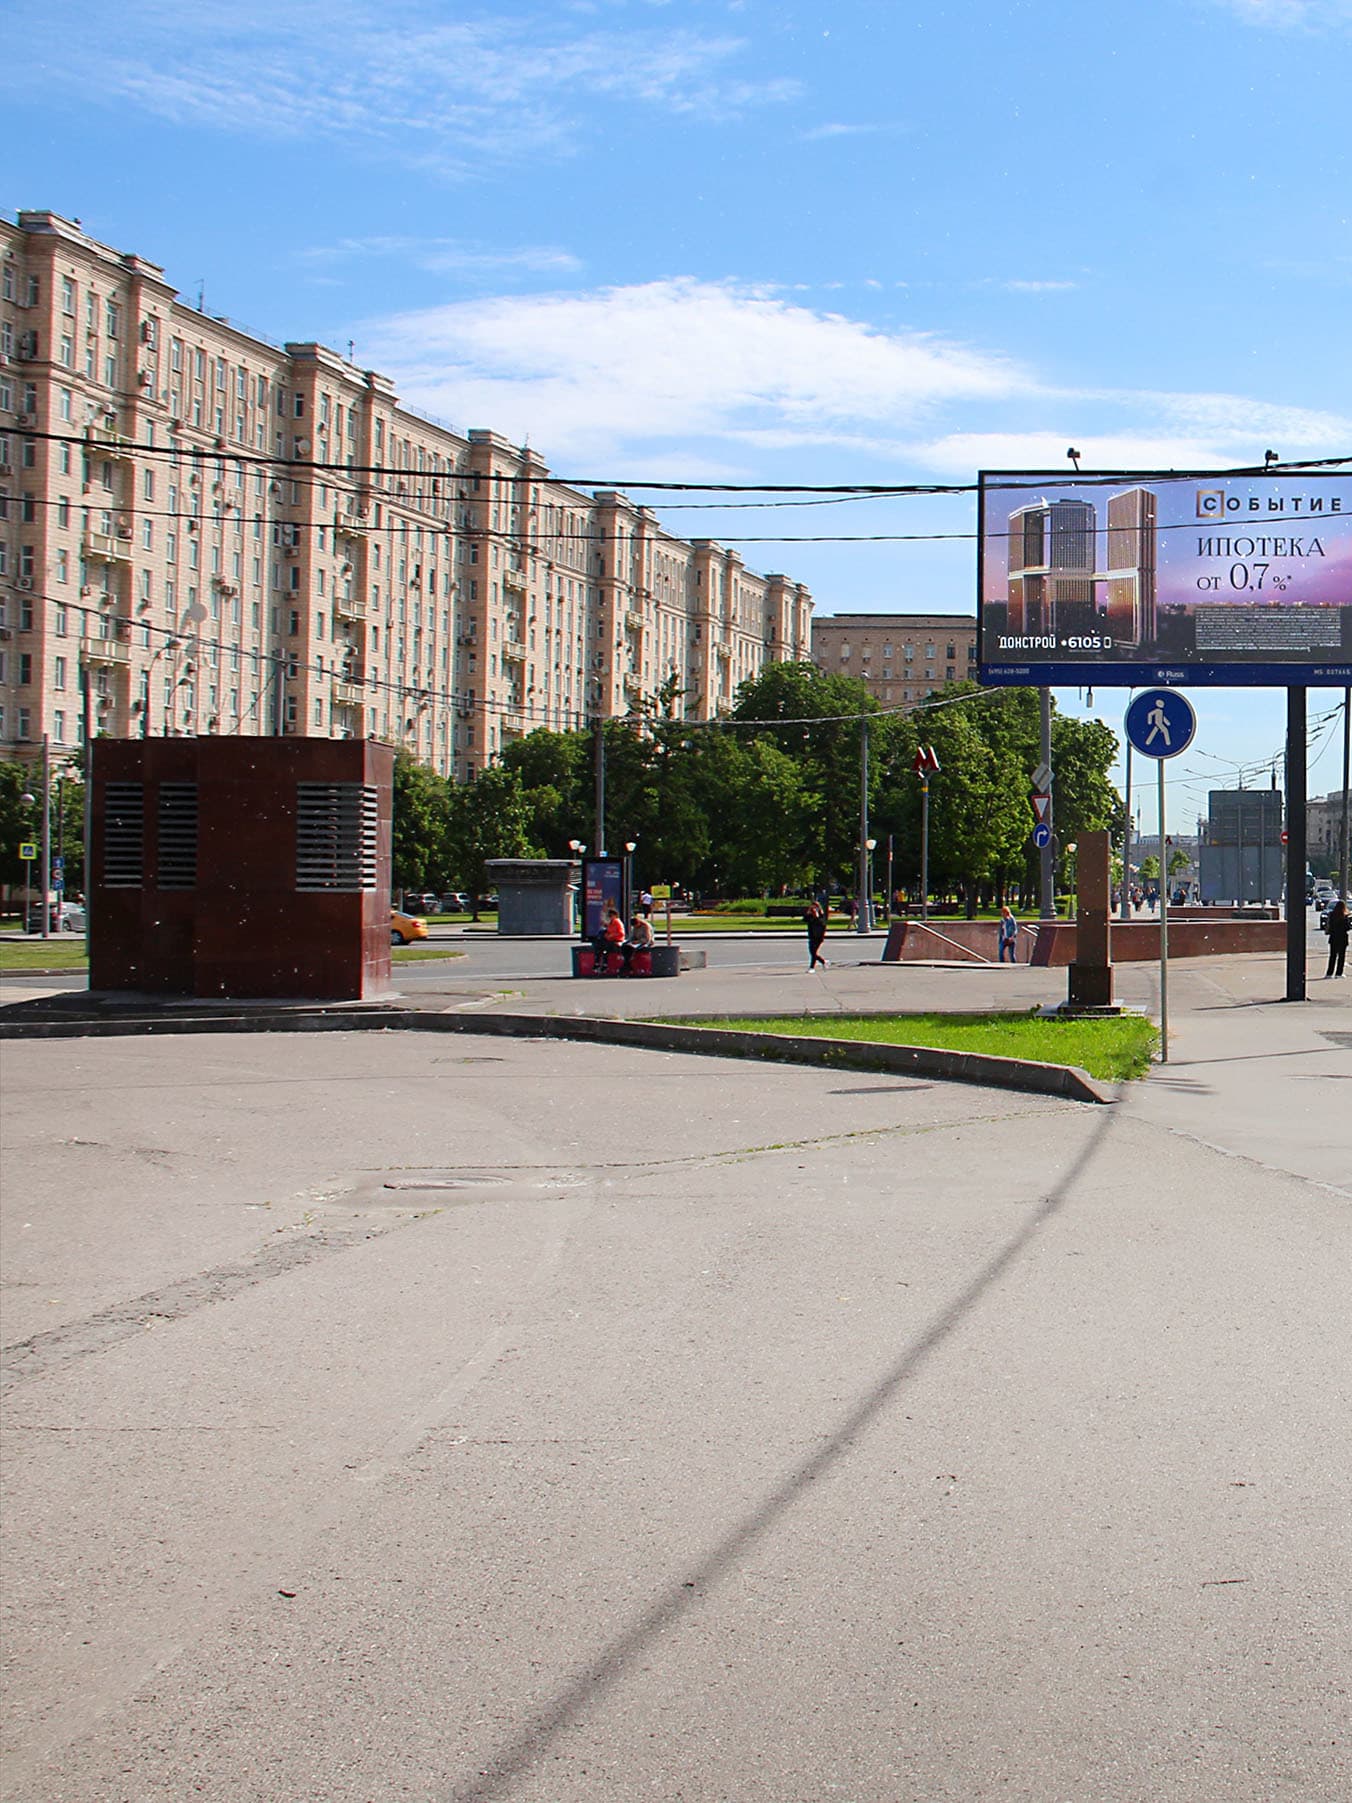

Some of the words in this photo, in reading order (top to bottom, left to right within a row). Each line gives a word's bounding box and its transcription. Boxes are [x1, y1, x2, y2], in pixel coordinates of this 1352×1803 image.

[1202, 496, 1342, 512] СОБЫТИЕ
[1196, 537, 1326, 558] ИПОТЕКА
[998, 634, 1056, 649] ДОНСТРОЙ
[1166, 670, 1185, 678] Russ
